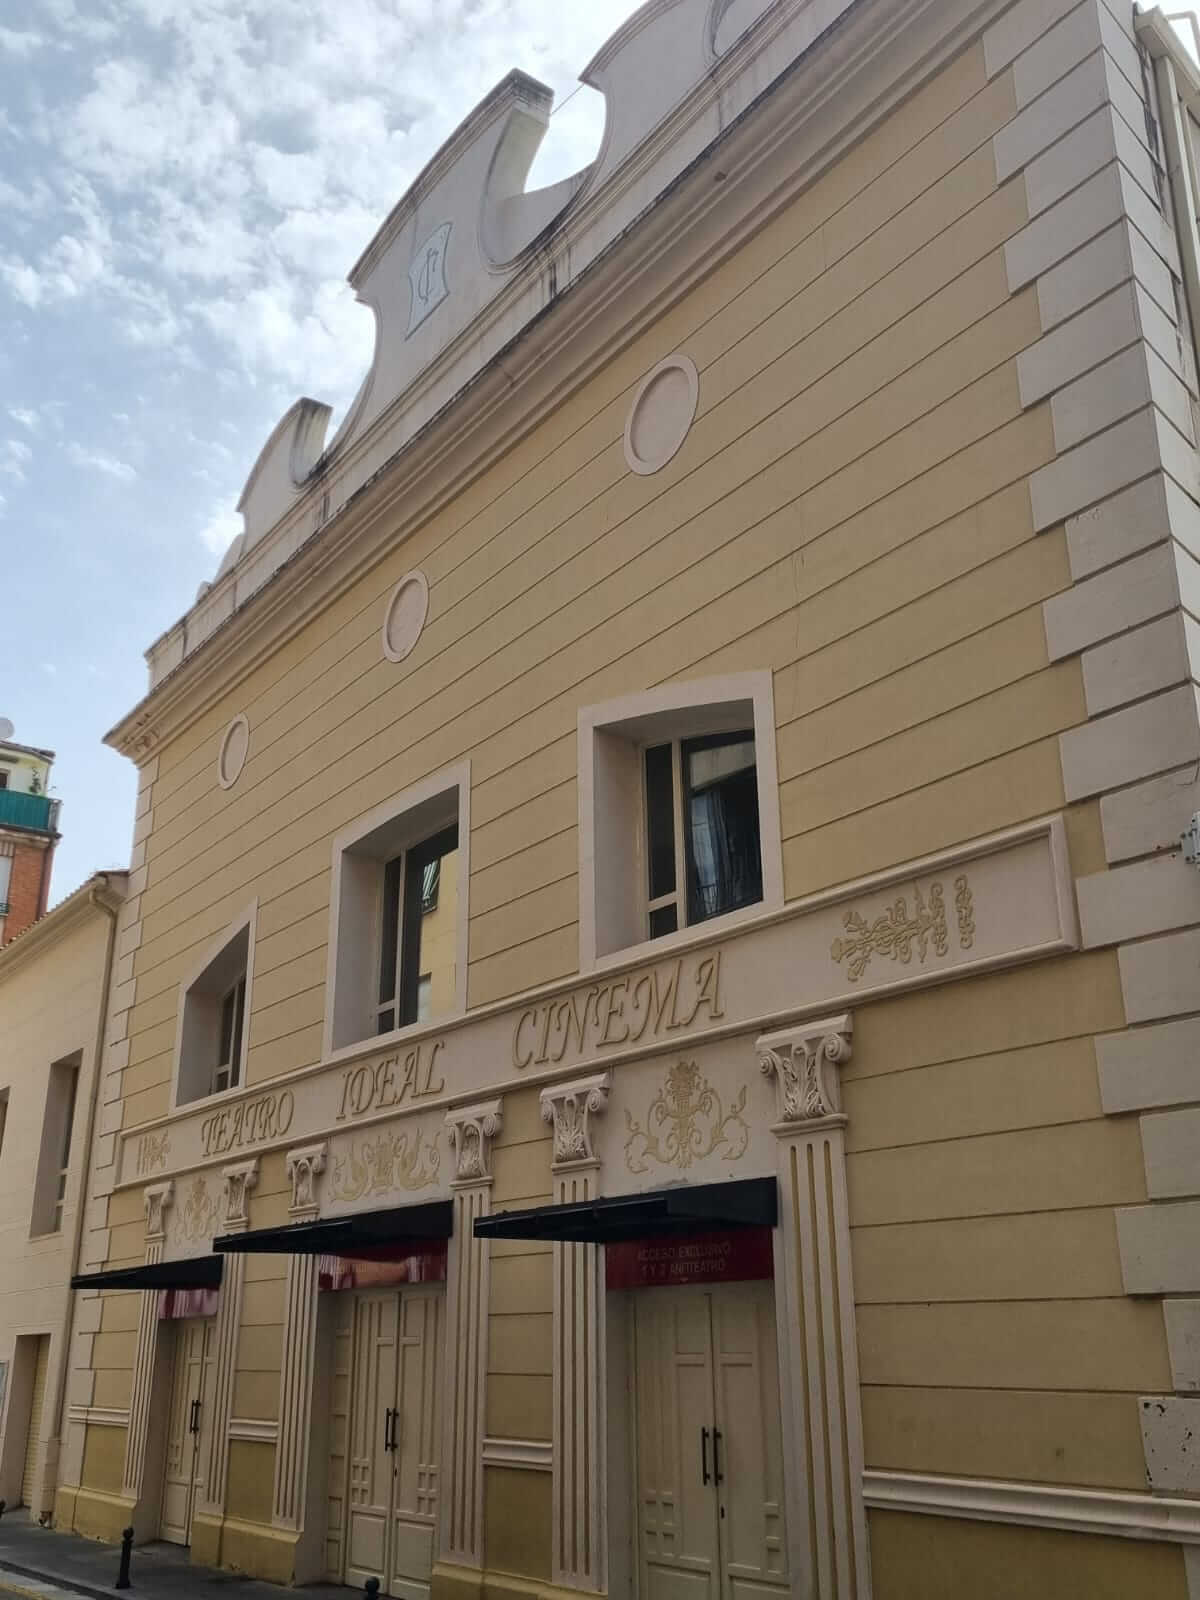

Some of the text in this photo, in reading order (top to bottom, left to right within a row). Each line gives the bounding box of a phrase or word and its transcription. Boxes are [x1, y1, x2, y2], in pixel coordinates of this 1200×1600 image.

[202, 951, 725, 1157] TEATRO IDEAL CINEMA
